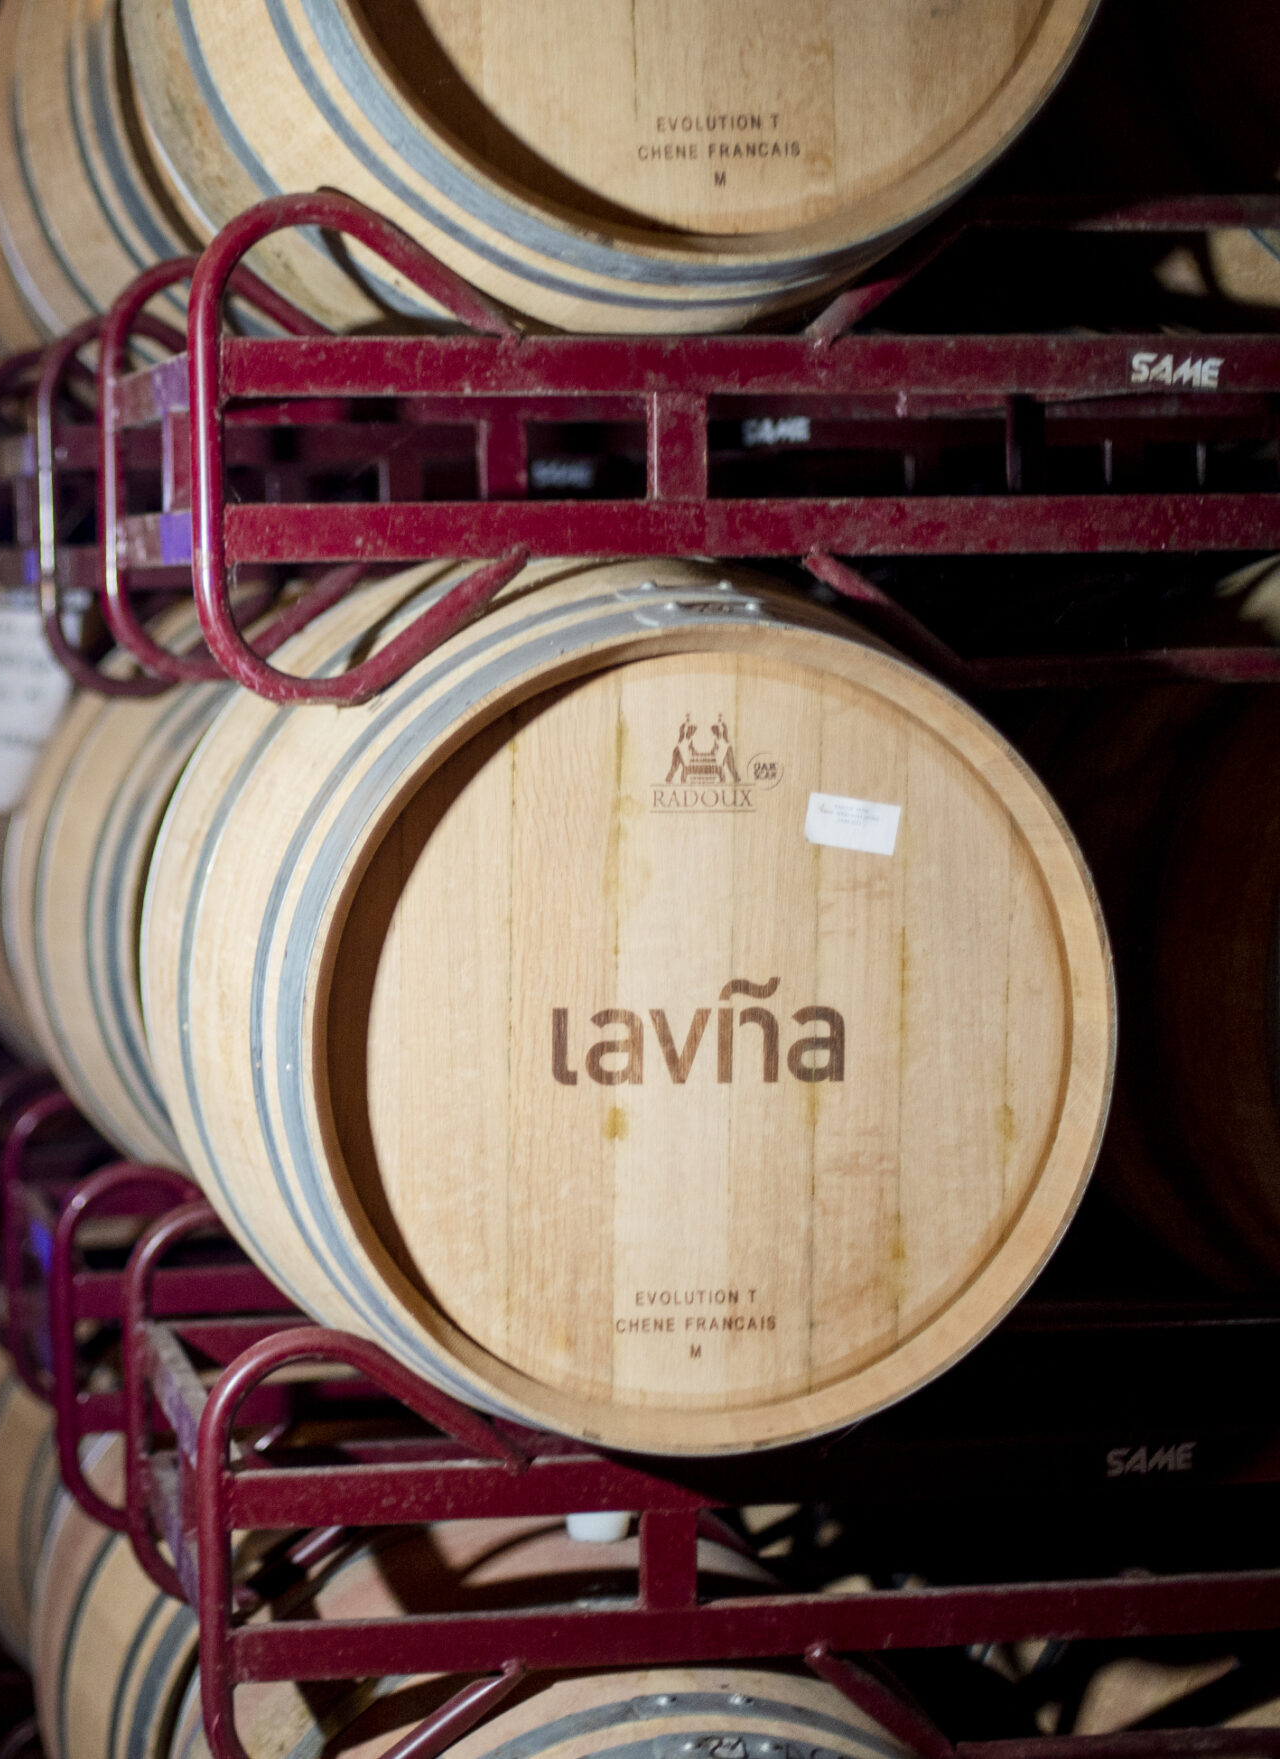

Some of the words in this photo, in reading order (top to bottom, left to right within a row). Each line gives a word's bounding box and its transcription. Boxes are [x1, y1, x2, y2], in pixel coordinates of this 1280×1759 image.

[656, 114, 762, 133] EVOLUTION
[770, 113, 780, 130] T
[637, 143, 699, 161] CHENE
[708, 140, 802, 159] FRANCAIS
[714, 170, 727, 187] M
[1130, 351, 1226, 389] SAME
[653, 789, 753, 808] RADOUX
[635, 1289, 739, 1306] EVOLUTION
[748, 1289, 758, 1304] T
[615, 1317, 675, 1333] CHENE
[685, 1315, 777, 1332] FRANCAIS
[689, 1343, 703, 1359] M
[1105, 1440, 1198, 1478] SAME
